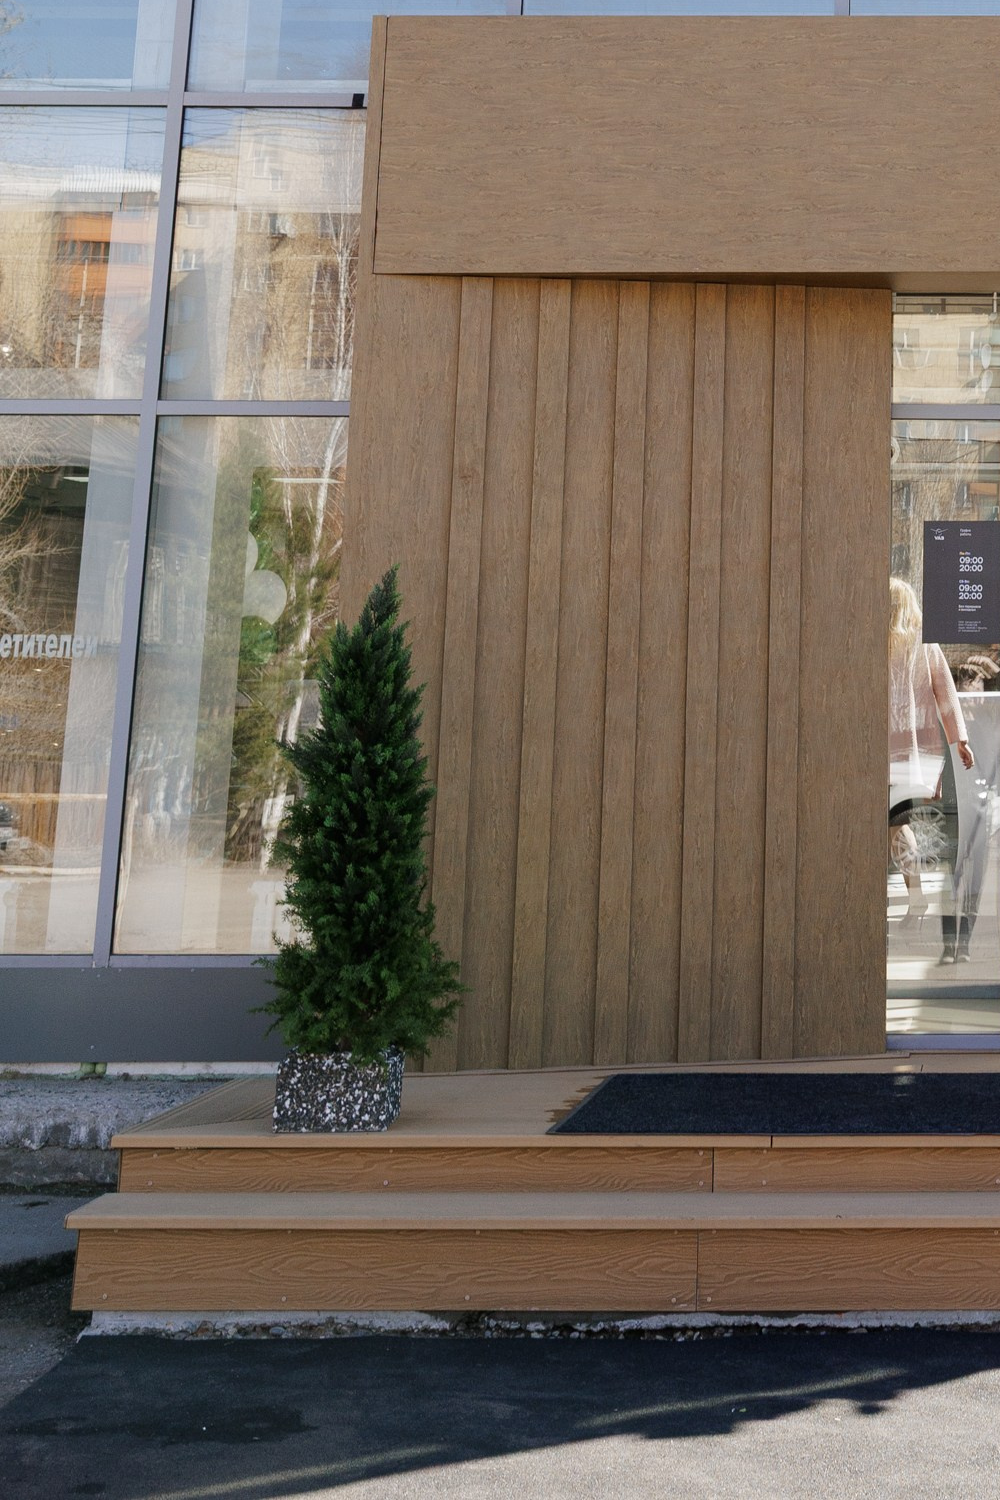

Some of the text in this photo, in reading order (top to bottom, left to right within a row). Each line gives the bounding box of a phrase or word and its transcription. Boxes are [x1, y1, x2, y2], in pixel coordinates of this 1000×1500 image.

[959, 556, 983, 564] 09:00
[959, 564, 983, 572] 20:00
[958, 584, 983, 592] 09:00
[958, 592, 983, 600] 20:00
